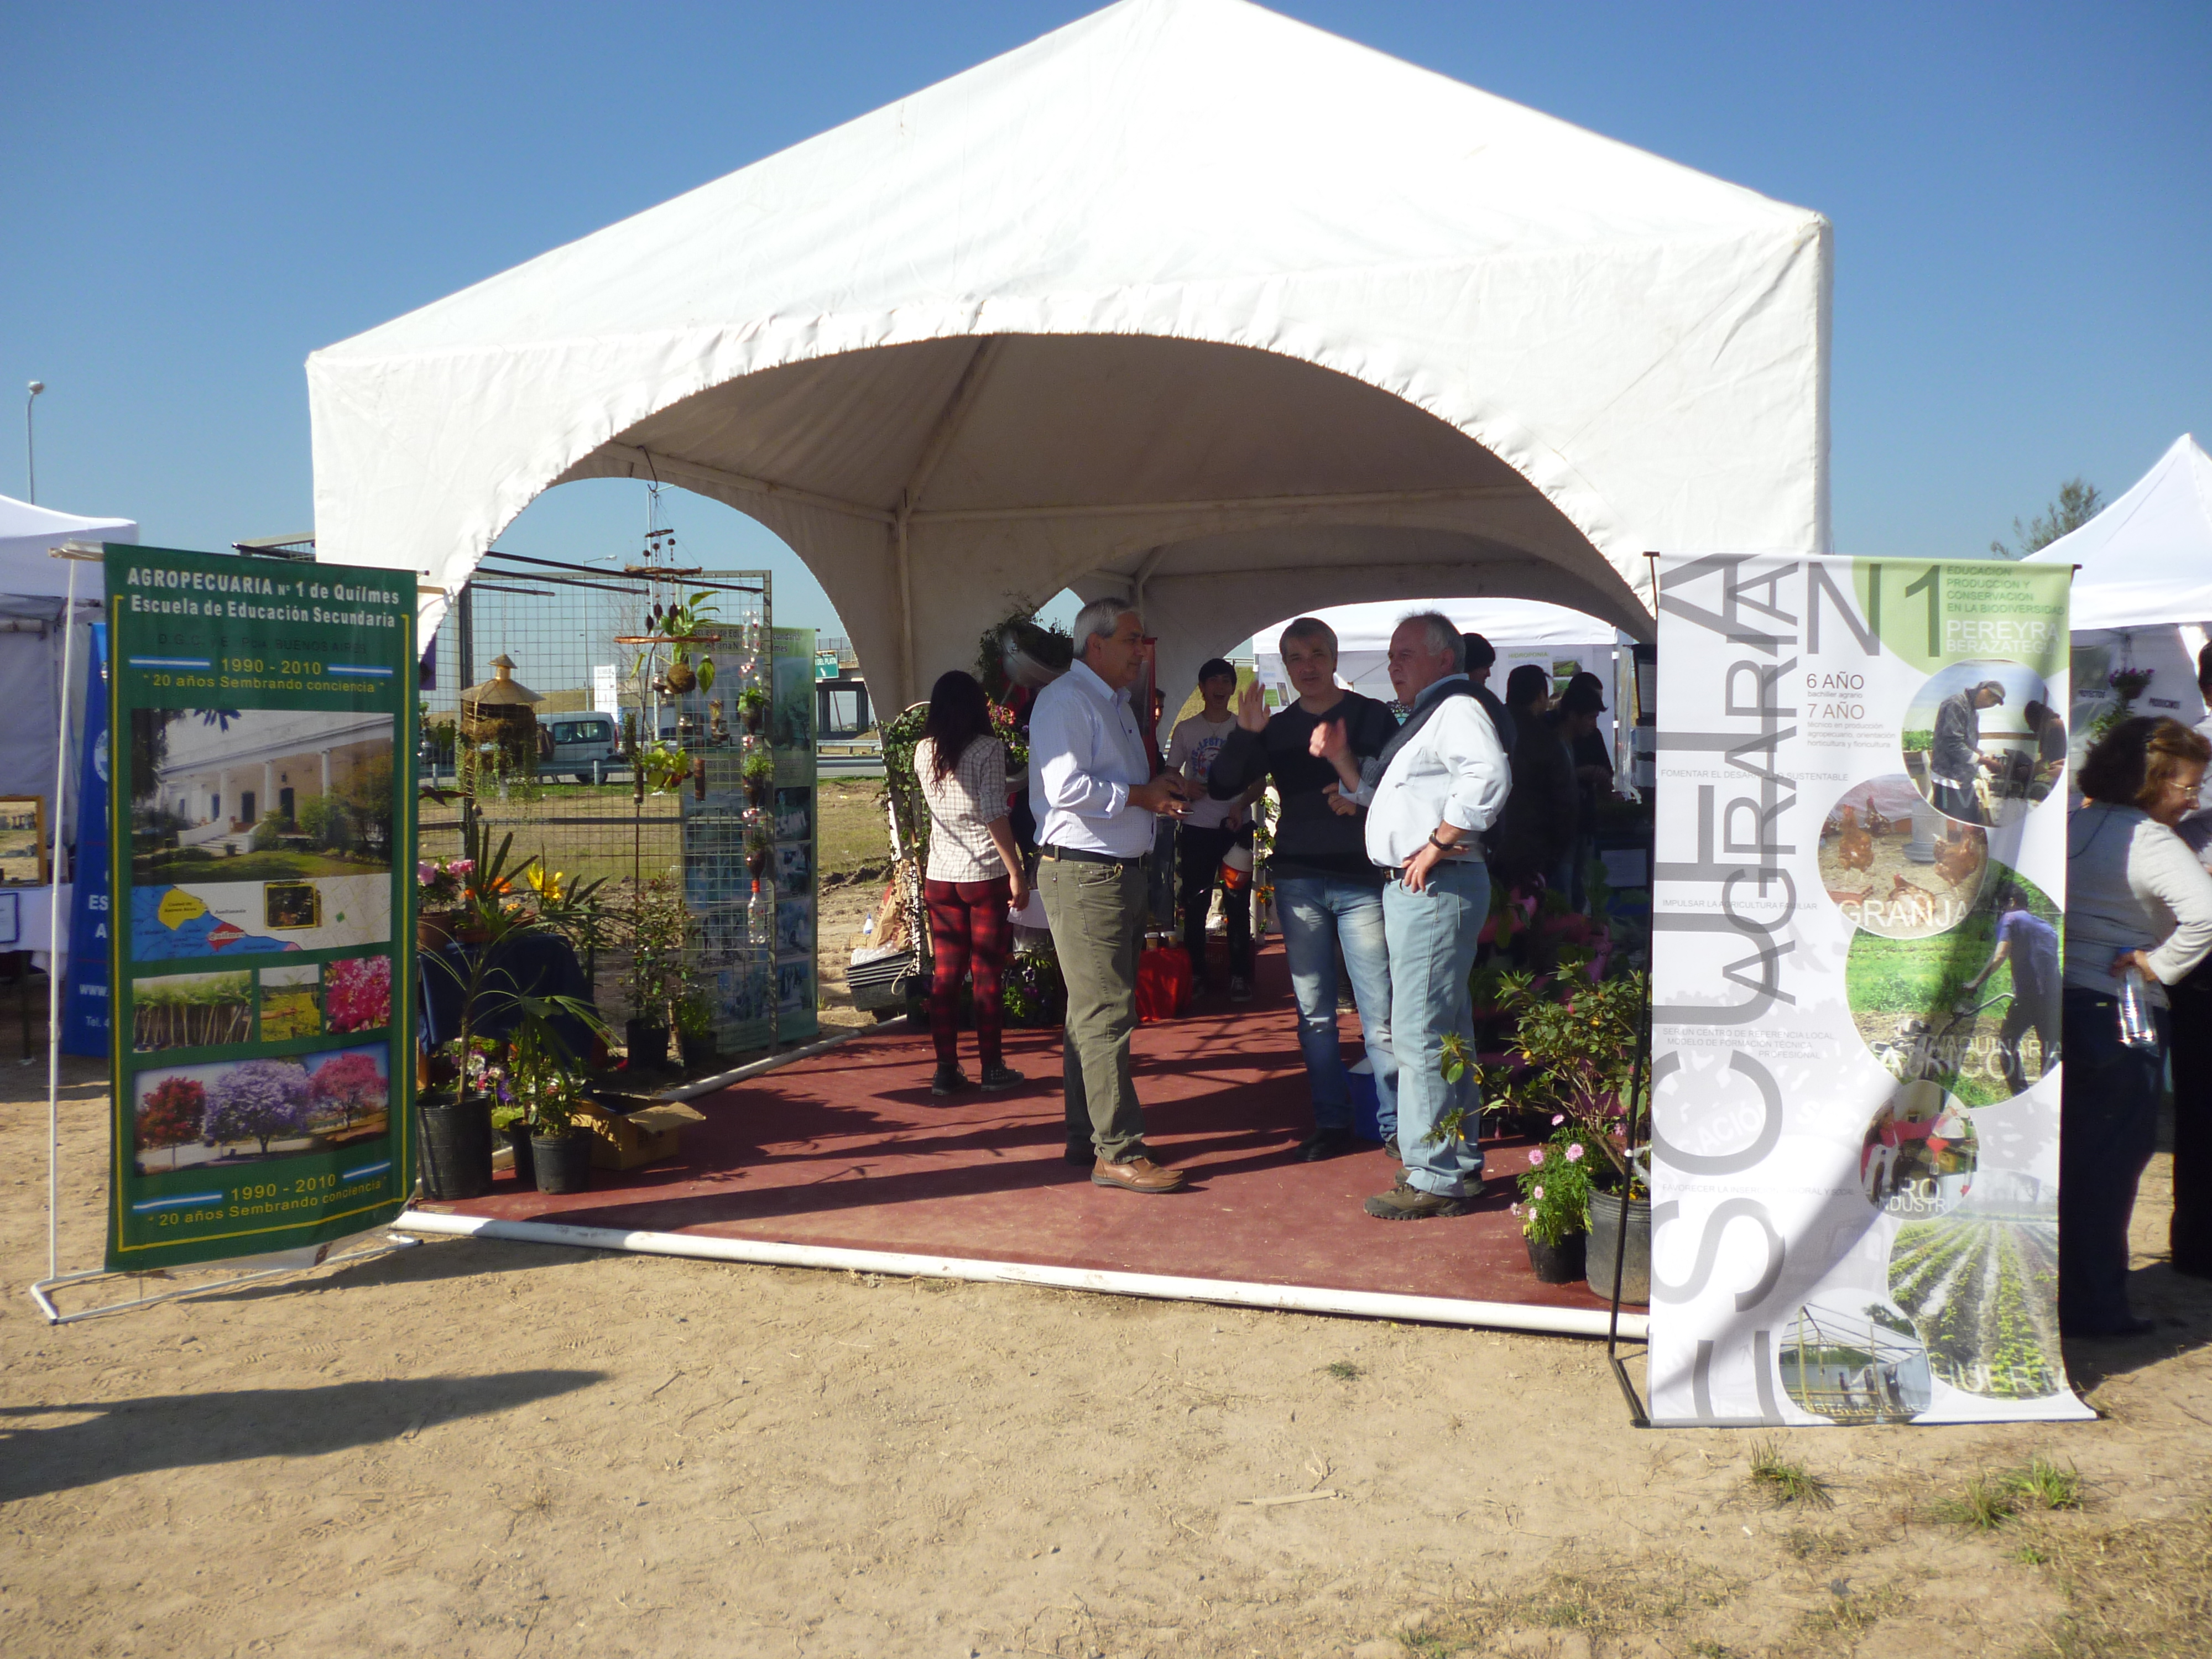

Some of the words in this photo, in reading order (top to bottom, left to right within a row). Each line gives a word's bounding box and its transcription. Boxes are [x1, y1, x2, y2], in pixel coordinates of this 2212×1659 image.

[1947, 566, 2012, 576] EDUCACION
[127, 567, 273, 595] AGROPECUARIA
[296, 581, 304, 597] 1
[310, 582, 328, 599] de
[334, 584, 399, 604] Quilmes
[1947, 579, 2020, 589] PRODUCCION
[1947, 591, 2033, 601] CONSERVACION
[131, 594, 198, 615] Escuela
[204, 599, 222, 617] de
[227, 601, 309, 622] Educación
[313, 607, 395, 628] Secundaria
[1947, 603, 1960, 612] EN
[1964, 603, 1978, 613] LA
[1981, 604, 2065, 615] BIODIVERSIDAD
[1947, 619, 2060, 642] PEREYRA
[222, 658, 263, 672] 1990
[281, 660, 321, 675] 2010
[153, 674, 170, 686] 20
[176, 675, 215, 687] años
[220, 676, 302, 690] Sembrando
[306, 681, 374, 692] conciencia
[1807, 674, 1817, 688] 6
[1822, 671, 1864, 690] AÑO
[1807, 703, 1817, 718] 7
[1823, 701, 1864, 719] AÑO
[1661, 769, 1708, 778] FOMENTAR
[1787, 773, 1849, 781] SUSTENTABLE
[1721, 561, 1799, 1006] AGRARIA
[1719, 901, 1777, 909] AGRICULTURA
[1839, 899, 1968, 927] GRANJA
[1749, 1030, 1804, 1039] REFERENCIA
[1774, 1040, 1812, 1048] TÉCNICA
[1759, 1051, 1821, 1059] PROFESIONAL
[231, 1184, 276, 1201] 1990
[295, 1173, 336, 1193] 2010
[1662, 1184, 1715, 1193] FAVORECER
[159, 1213, 179, 1227] 20
[184, 1210, 223, 1223] años
[229, 1197, 318, 1217] Sembrando
[322, 1180, 381, 1204] conciencia
